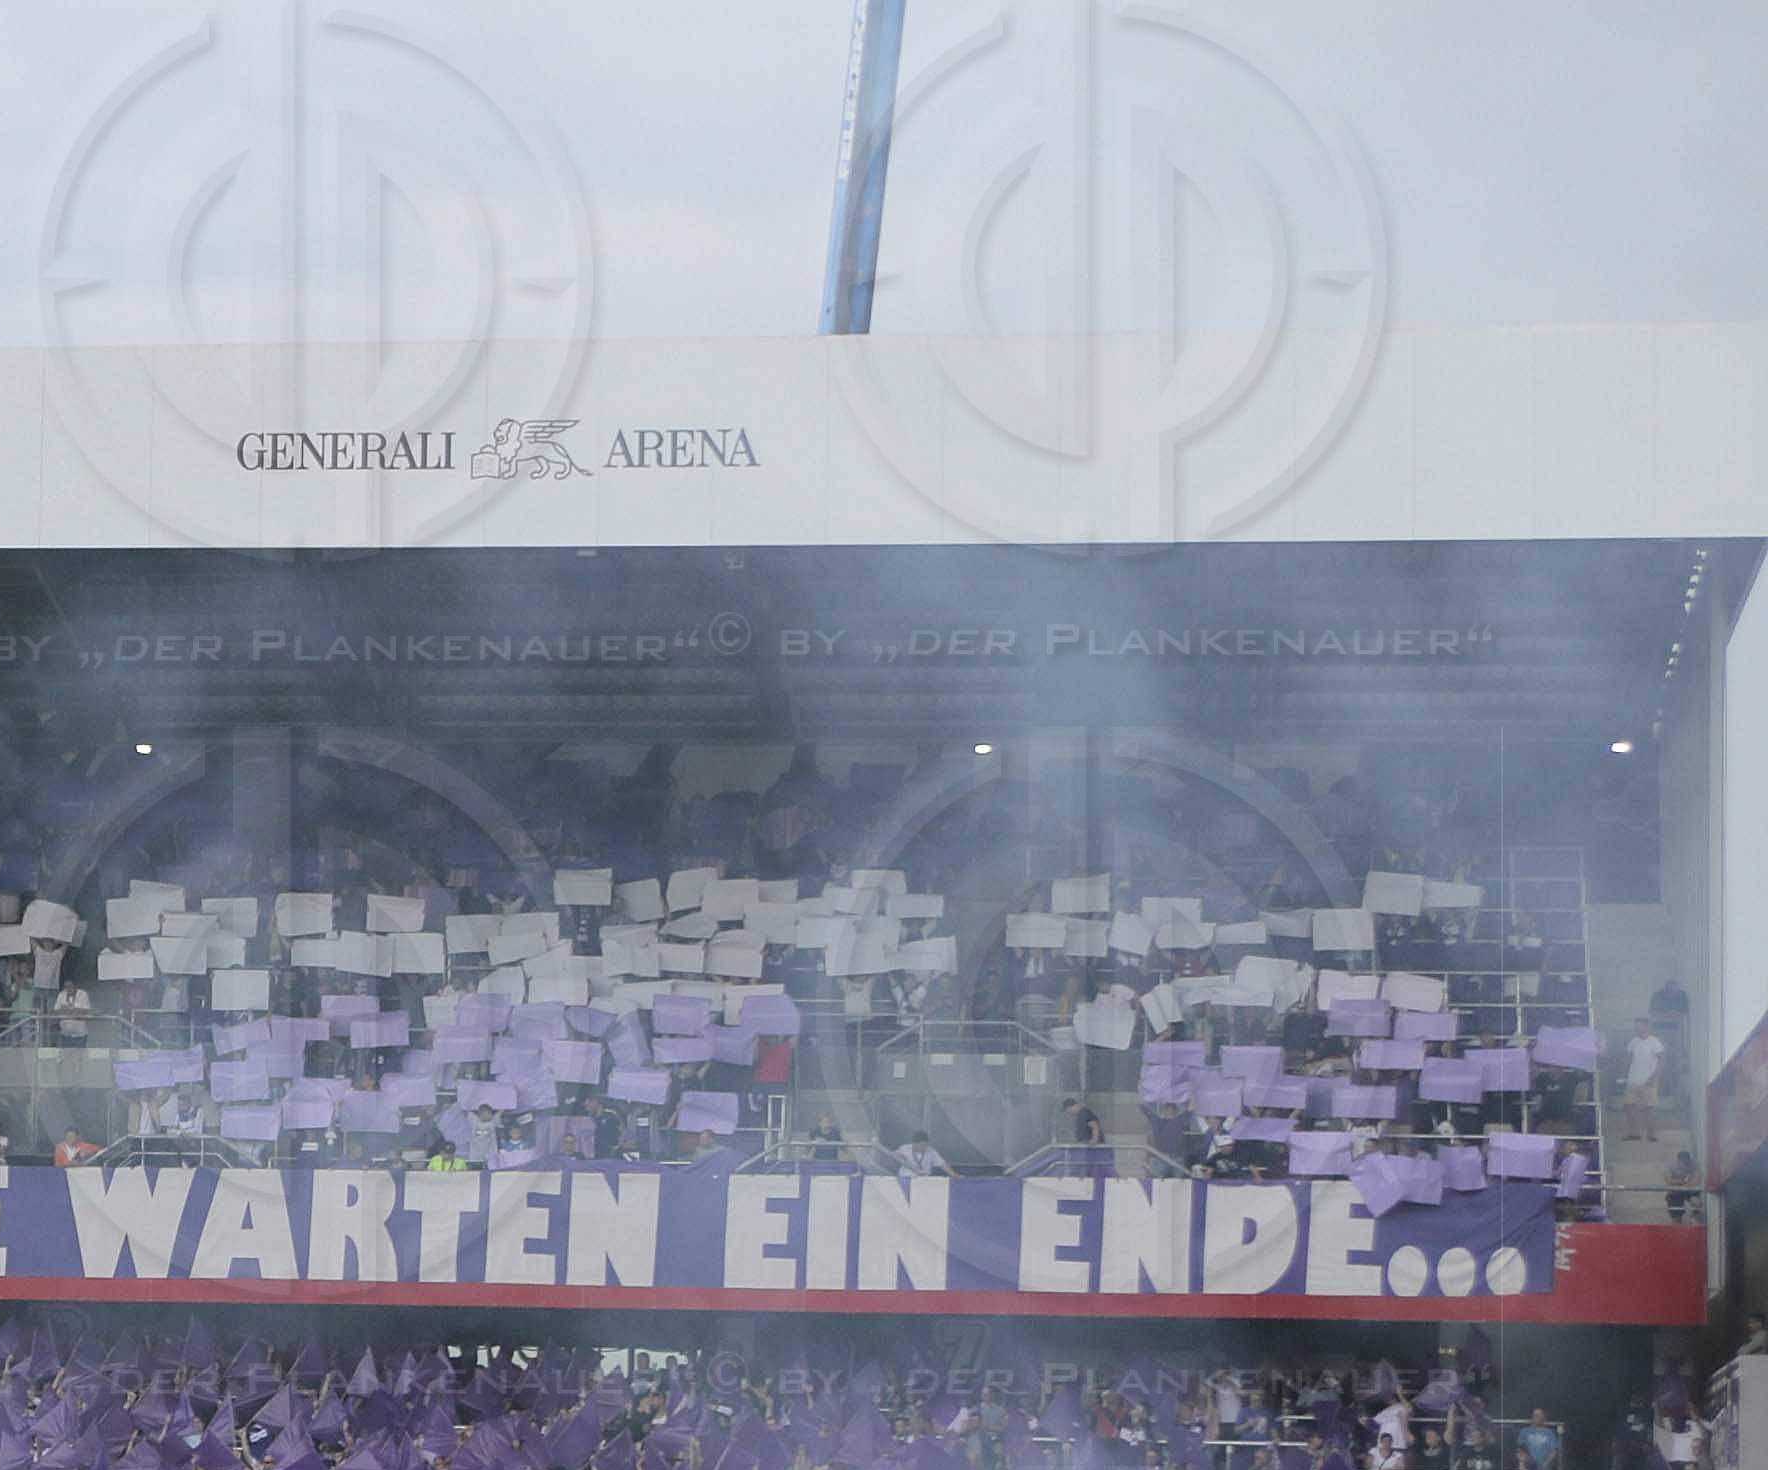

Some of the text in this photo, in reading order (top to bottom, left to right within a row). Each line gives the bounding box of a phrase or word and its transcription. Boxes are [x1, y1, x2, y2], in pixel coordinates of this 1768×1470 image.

[236, 427, 761, 471] GENERALI ARENA
[67, 1167, 661, 1287] WARTEN
[723, 1172, 952, 1292] EIN
[1017, 1175, 1527, 1297] ENDE...
